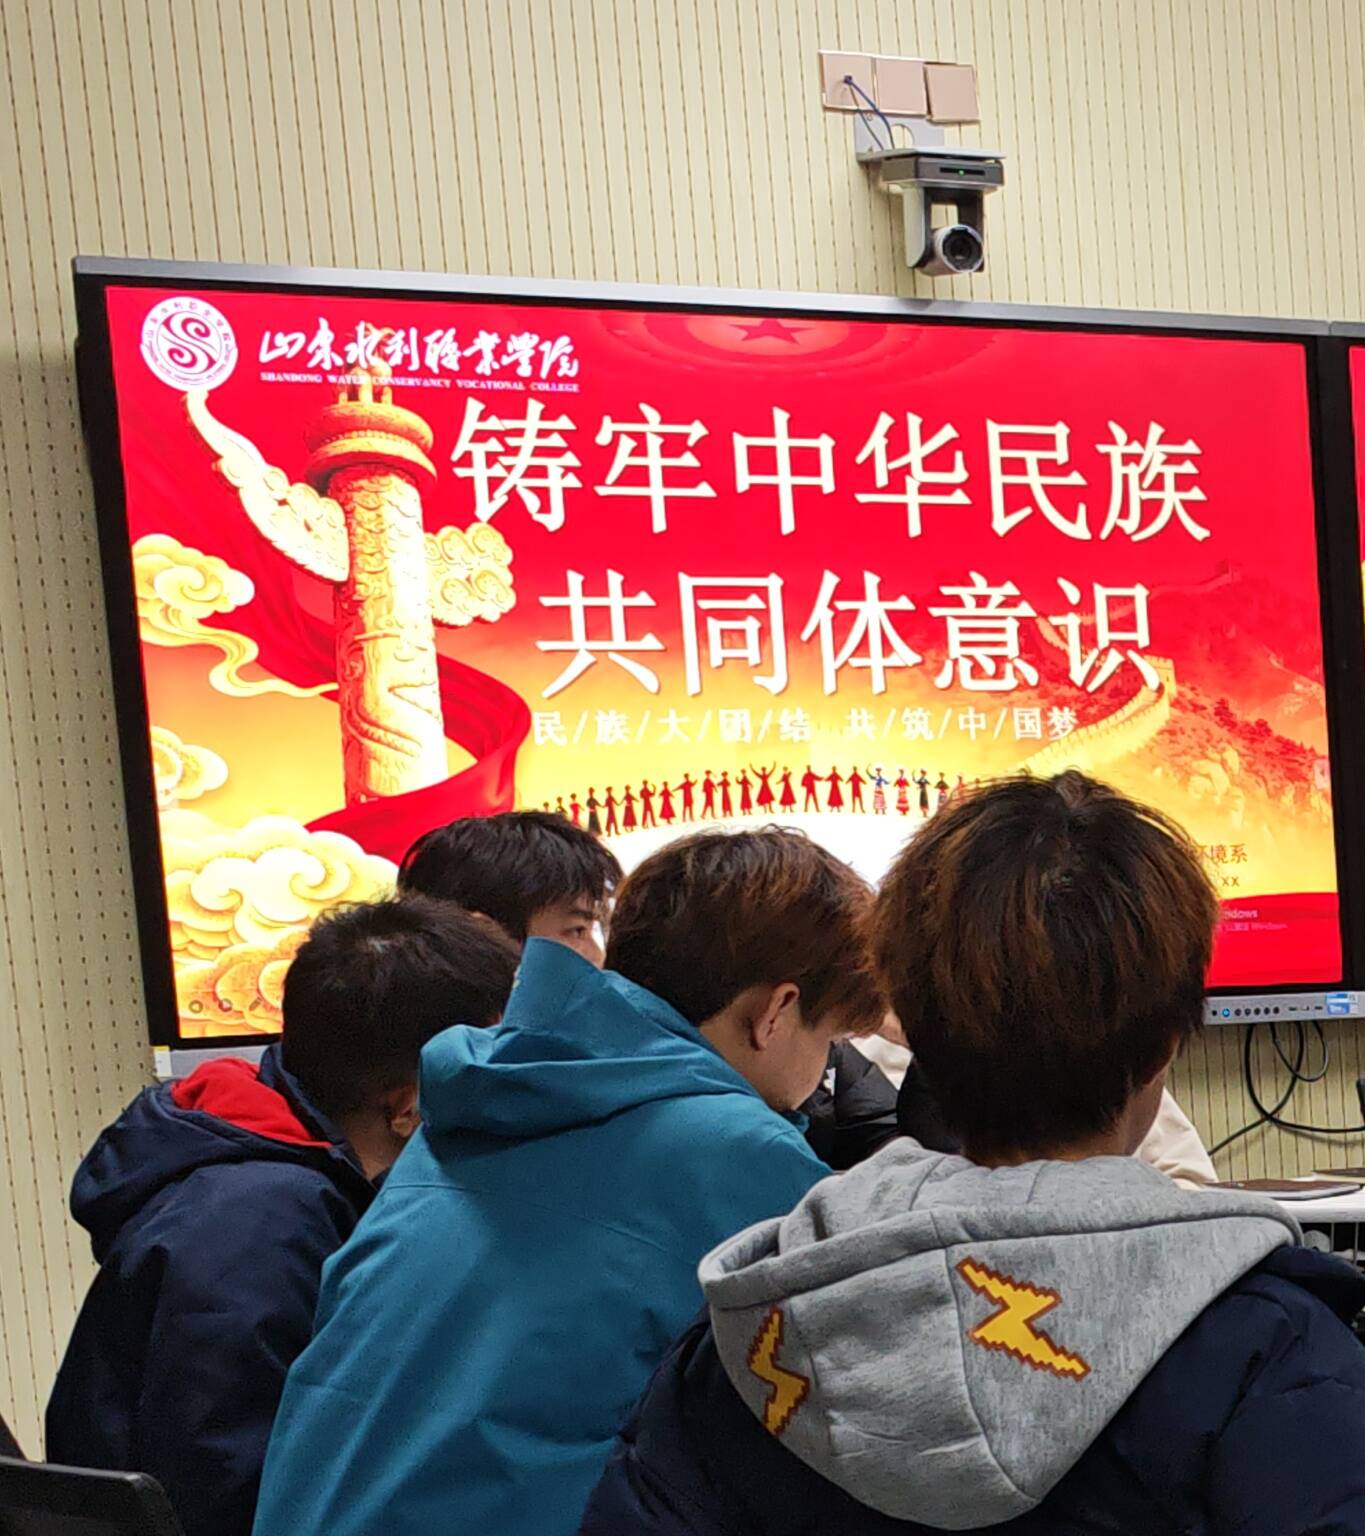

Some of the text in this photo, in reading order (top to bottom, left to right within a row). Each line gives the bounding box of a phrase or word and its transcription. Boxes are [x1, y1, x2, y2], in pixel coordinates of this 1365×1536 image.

[260, 371, 580, 393] SHANDONG WATER CONSERVANCY VOCATIONAL COLLEGE
[450, 396, 1212, 542] 铸牢中华民族
[535, 567, 1162, 698] 共同体意识
